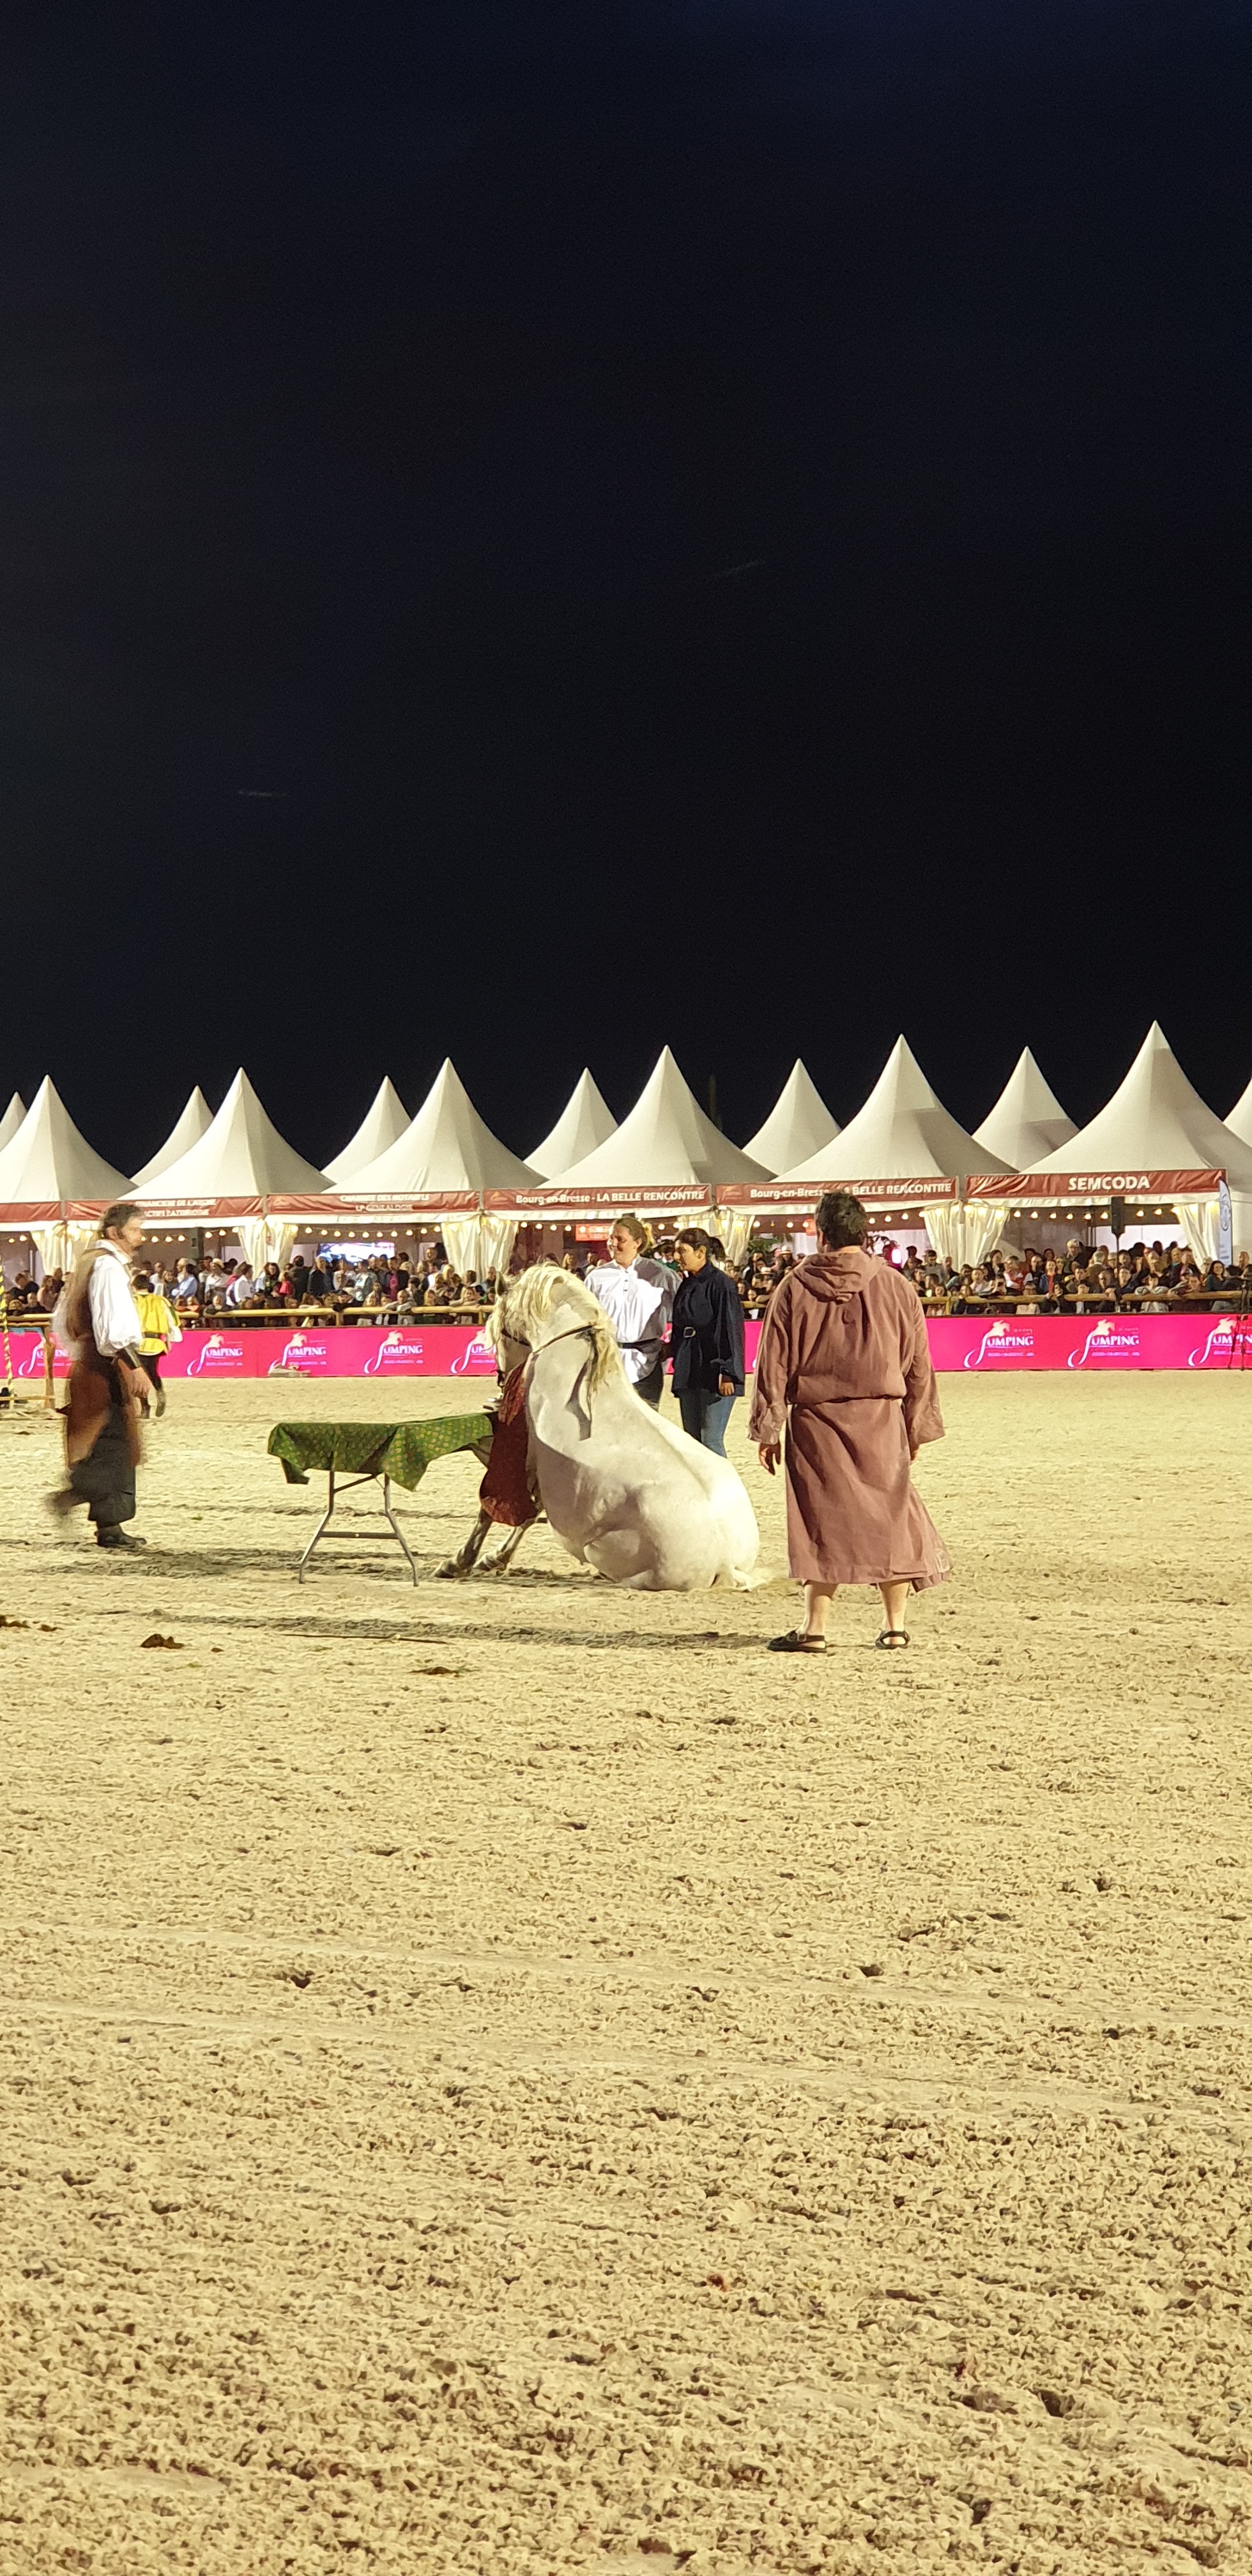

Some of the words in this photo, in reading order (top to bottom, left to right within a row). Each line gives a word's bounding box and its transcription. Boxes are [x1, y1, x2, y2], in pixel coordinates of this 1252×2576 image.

[515, 1194, 590, 1206] Bourg-en-Bresse
[597, 1193, 610, 1202] LA
[611, 1192, 641, 1201] BELLE
[643, 1191, 705, 1201] RENCONTRE
[852, 1186, 885, 1195] BELLE
[887, 1183, 952, 1194] RENCONTRE
[1067, 1176, 1150, 1191] SEMCODA
[187, 1344, 243, 1376] JUMPING
[363, 1341, 423, 1374] JUMPING
[964, 1331, 1034, 1368] JUMPING
[1067, 1331, 1140, 1367] JUMPING
